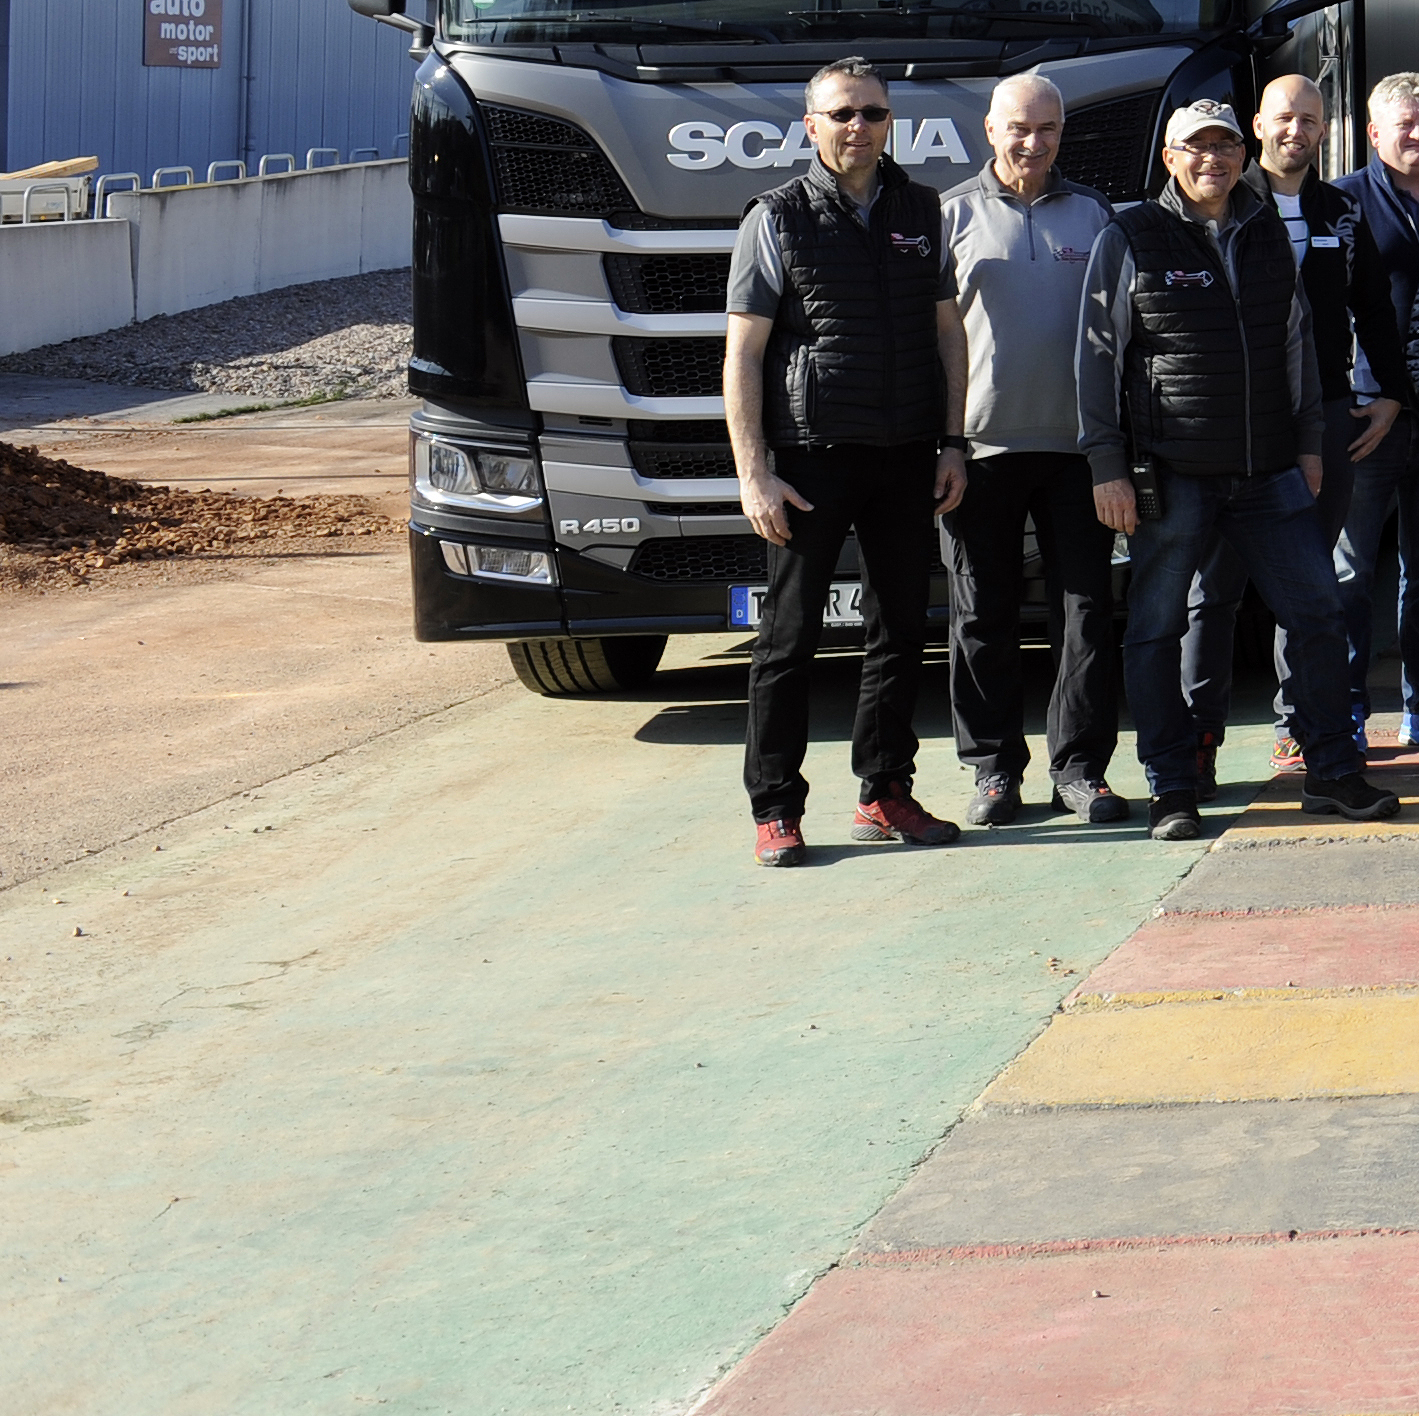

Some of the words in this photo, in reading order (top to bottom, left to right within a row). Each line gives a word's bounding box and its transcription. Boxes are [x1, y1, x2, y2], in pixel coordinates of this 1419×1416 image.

[161, 20, 214, 41] motor
[178, 44, 218, 64] sport
[666, 117, 971, 171] SCAIA
[560, 519, 580, 535] R
[582, 517, 640, 534] 450
[735, 609, 744, 619] D
